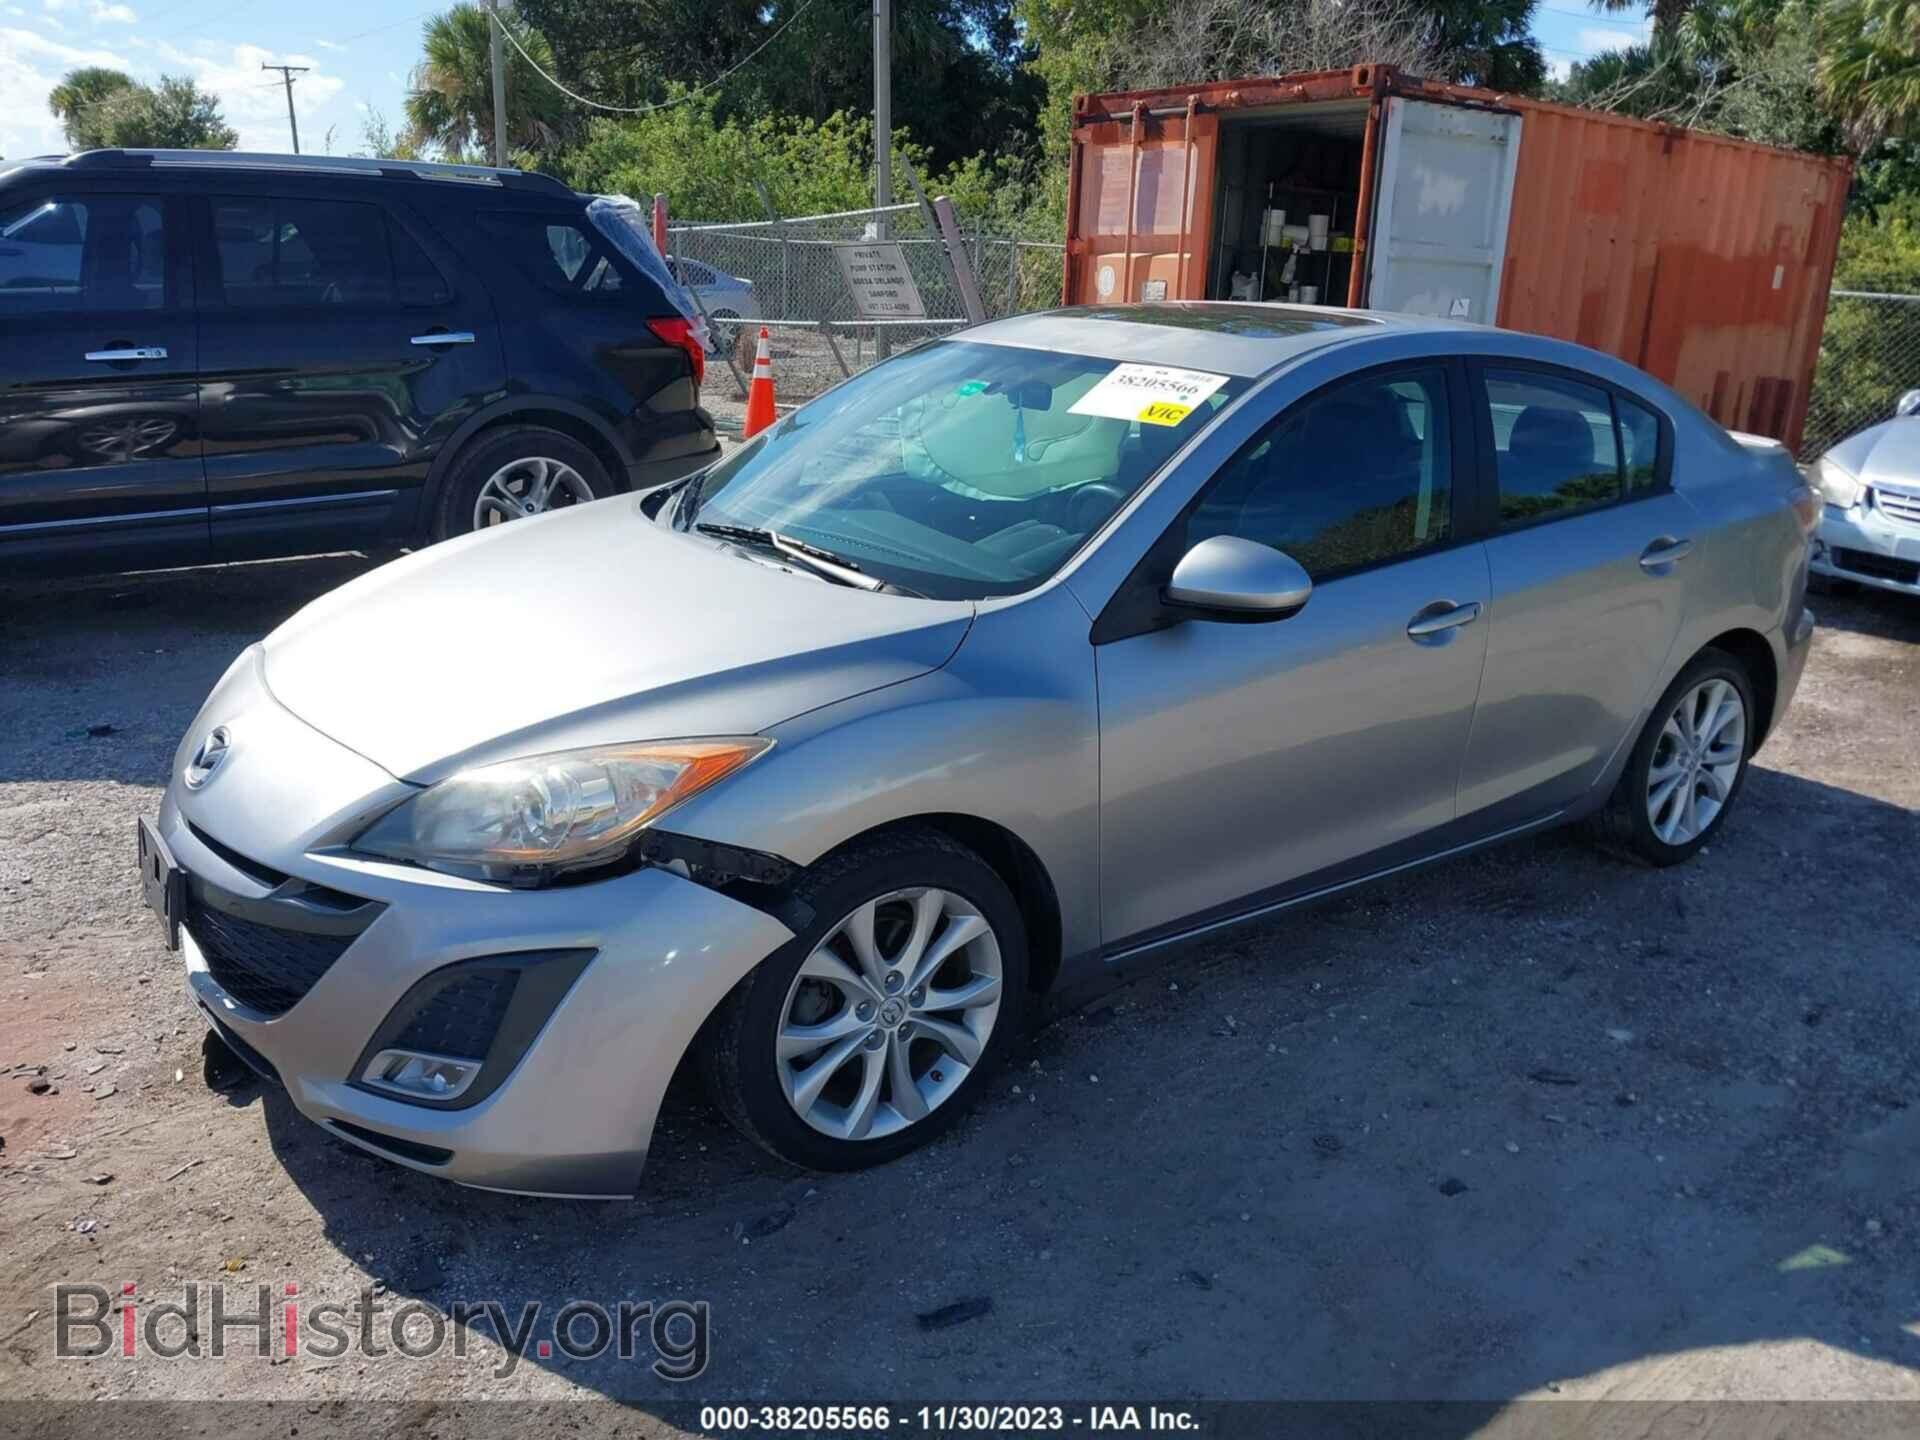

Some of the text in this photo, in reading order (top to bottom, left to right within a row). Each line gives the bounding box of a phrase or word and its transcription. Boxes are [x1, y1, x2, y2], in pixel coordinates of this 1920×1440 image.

[868, 264, 897, 272] STATION
[873, 277, 905, 285] ORLANDO
[1147, 405, 1184, 420] VIC
